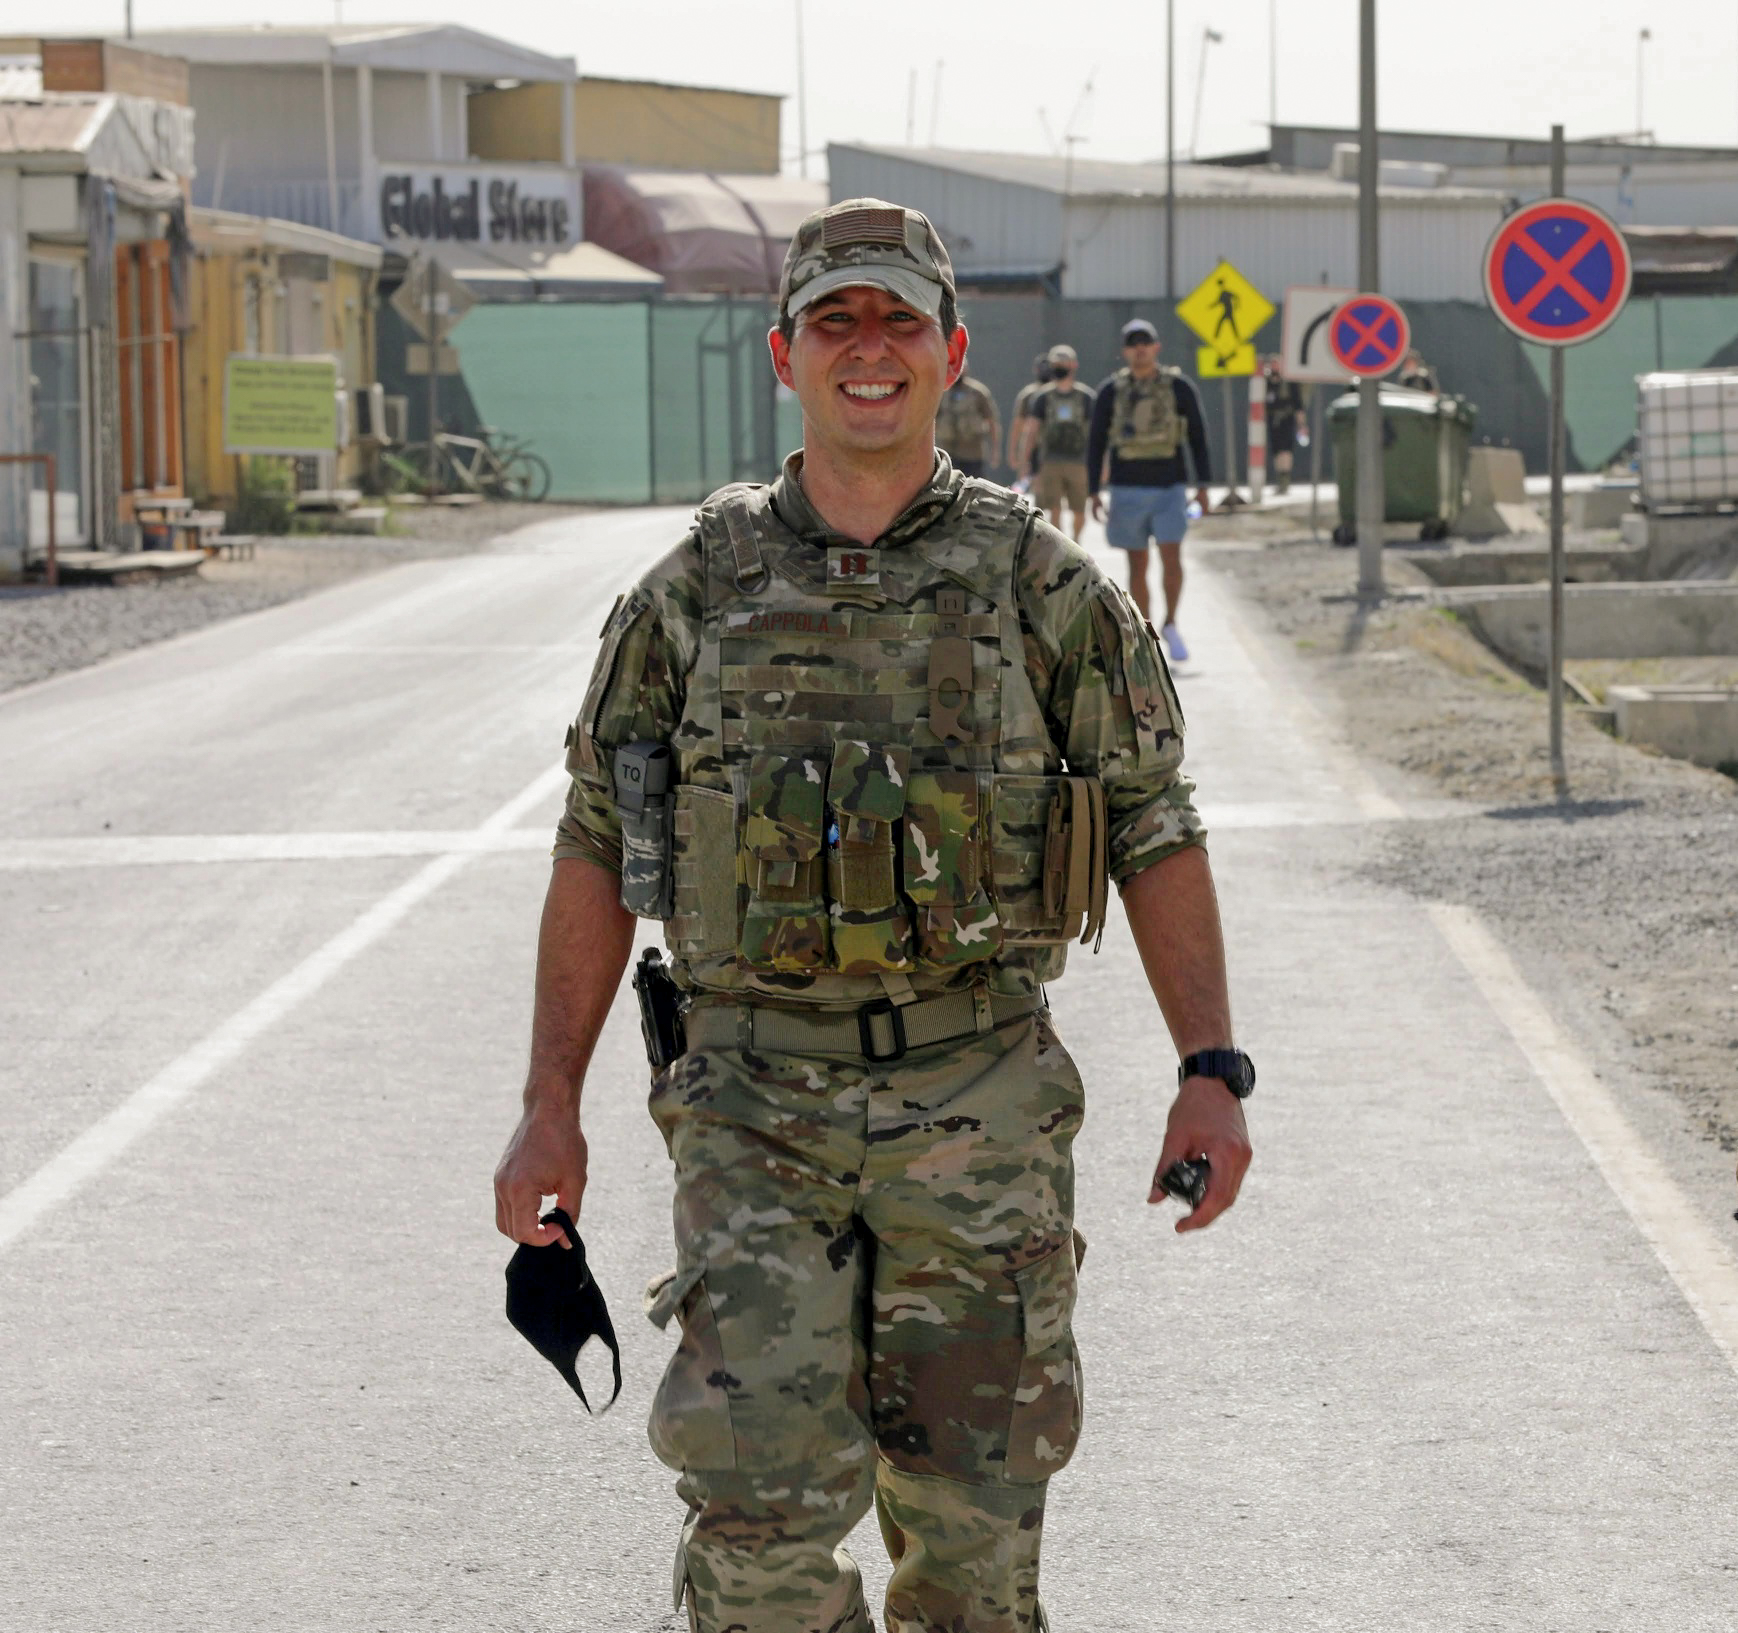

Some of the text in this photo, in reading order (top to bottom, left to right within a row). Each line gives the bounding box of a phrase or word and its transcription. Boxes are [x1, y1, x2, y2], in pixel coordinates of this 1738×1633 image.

[381, 175, 568, 242] Global Store
[749, 612, 829, 632] CAPPOLA
[622, 763, 640, 783] TQ
